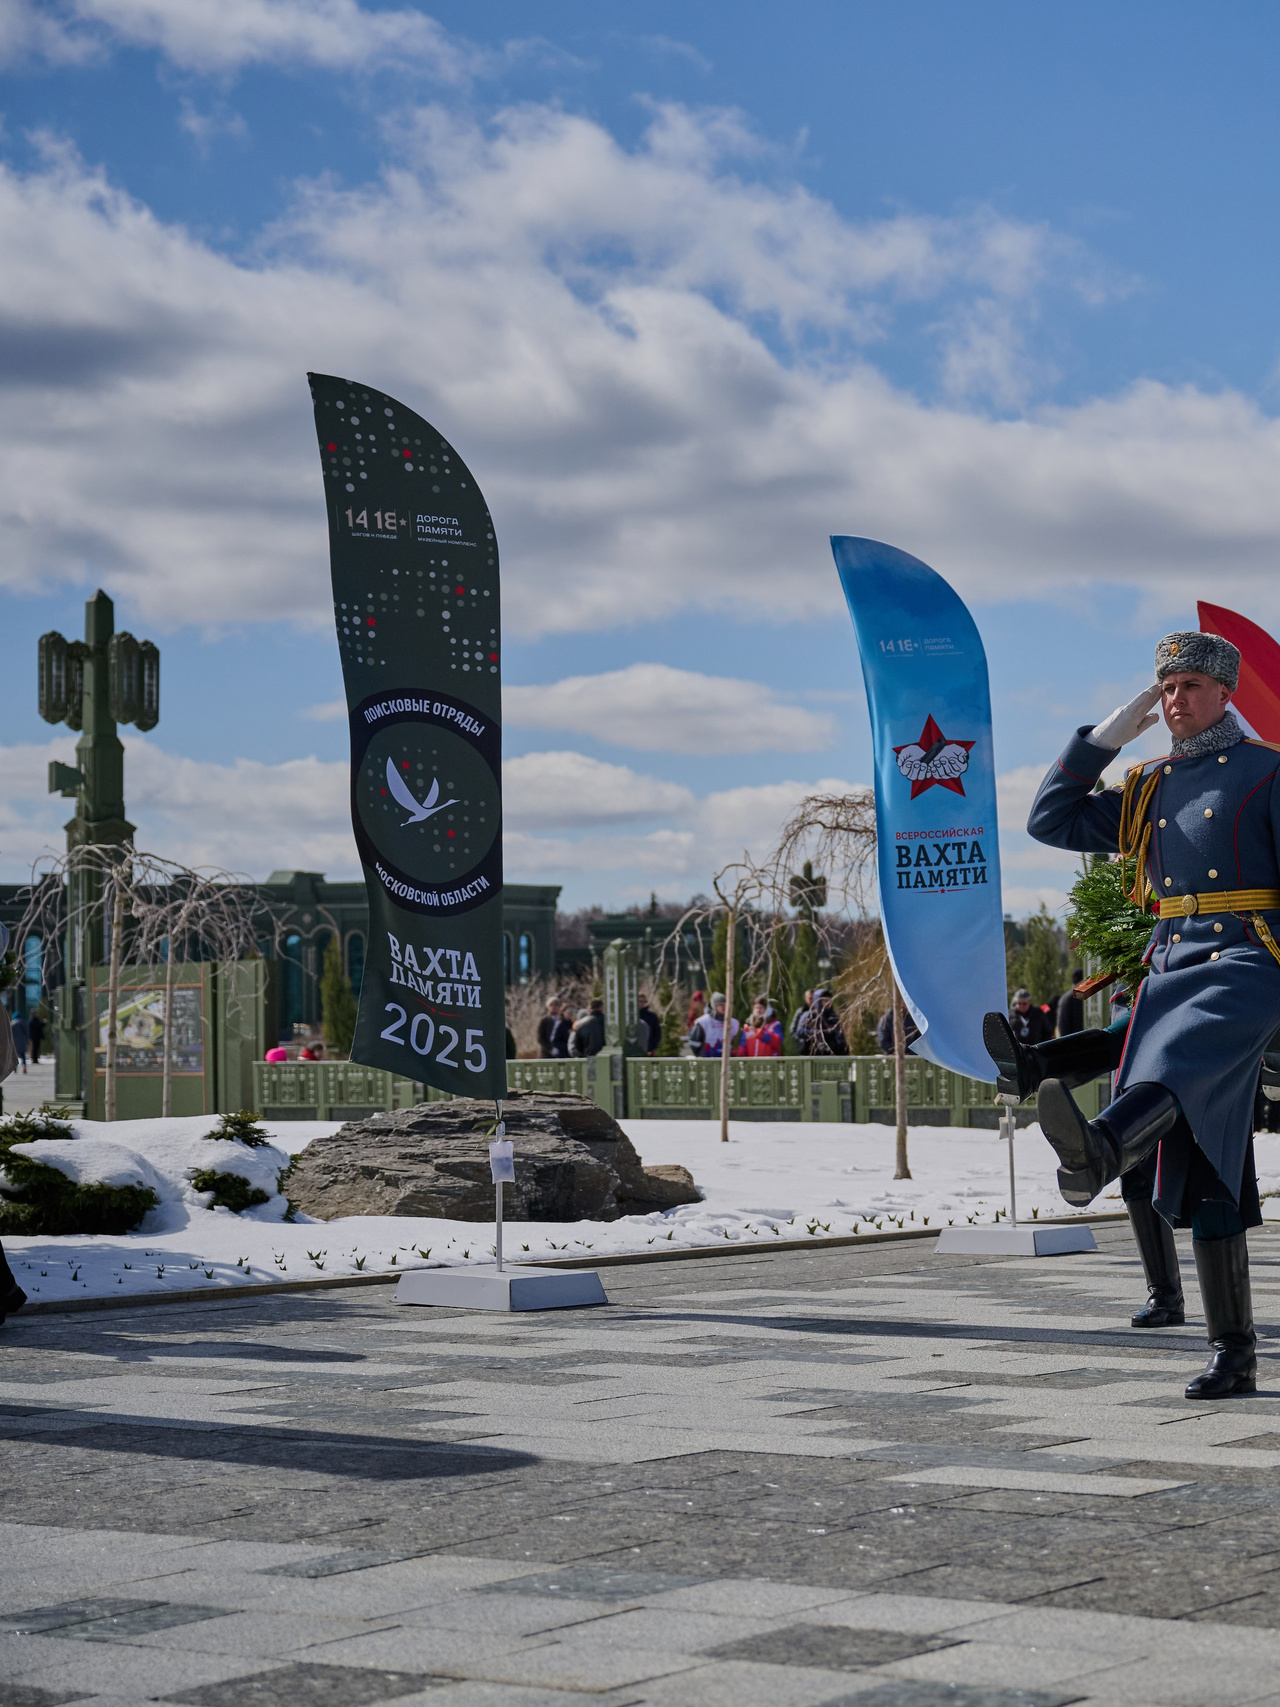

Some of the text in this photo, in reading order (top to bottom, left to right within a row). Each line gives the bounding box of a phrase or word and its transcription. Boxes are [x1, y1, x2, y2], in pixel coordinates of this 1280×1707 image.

[416, 514, 459, 526] ДОРОГА
[417, 525, 462, 537] ПАМЯТИ
[364, 698, 486, 737] ПОИСКОВЫЕ ОТРЯДЫ
[896, 827, 984, 840] ВСЕРОССИЙСКАЯ
[895, 840, 986, 868] ВАХТА
[375, 862, 491, 907] МОСКОВСКОЙ ОБЛАСТИ
[896, 866, 988, 889] ПАМЯТИ
[387, 931, 482, 982] ВАХТА
[389, 960, 482, 1008] ПАМЯТИ
[380, 1002, 487, 1073] 2025
